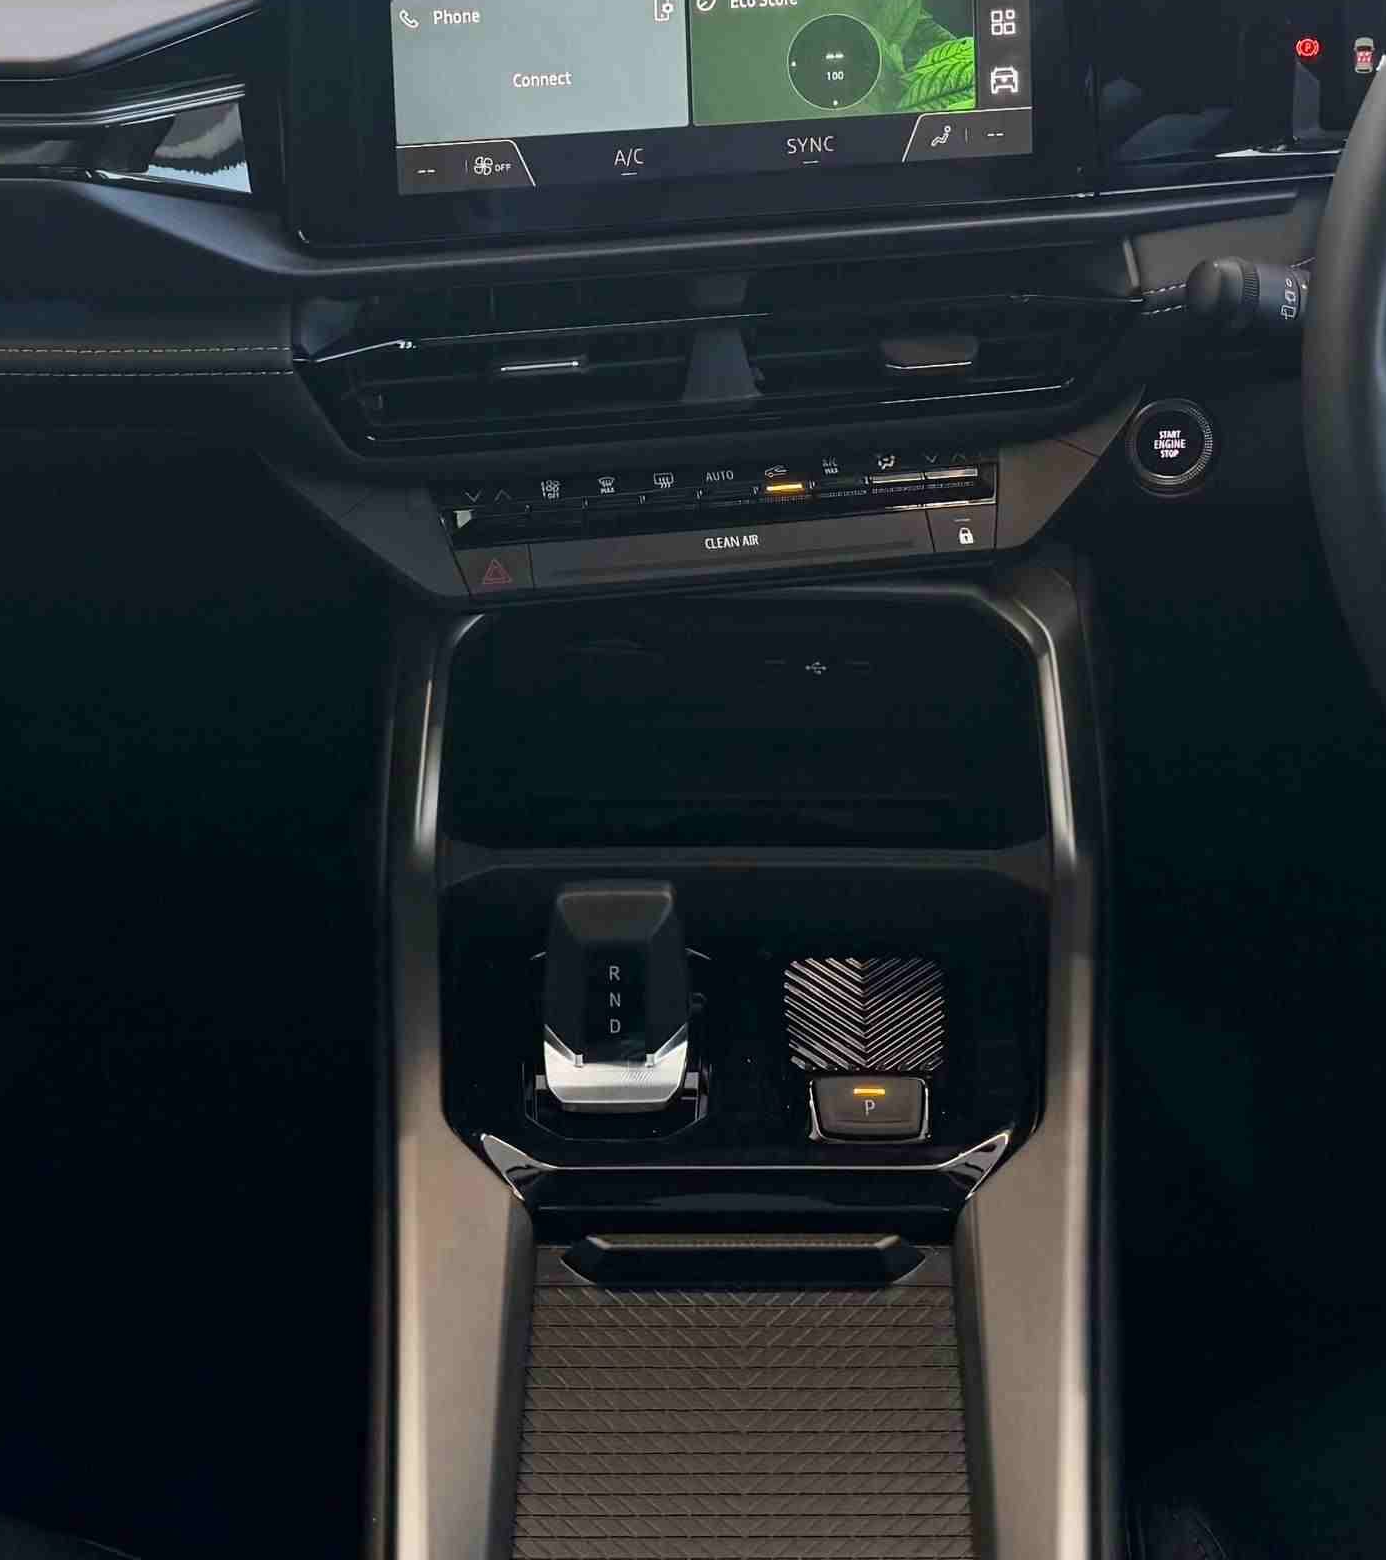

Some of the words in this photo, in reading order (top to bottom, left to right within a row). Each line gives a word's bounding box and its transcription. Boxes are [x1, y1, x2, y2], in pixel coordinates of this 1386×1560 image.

[433, 9, 481, 25] Phone
[513, 71, 573, 89] Connect
[826, 71, 844, 81] 100
[787, 135, 835, 154] SYNC
[614, 148, 646, 167] A/C
[495, 163, 512, 173] OFF
[1158, 430, 1182, 440] START
[1154, 439, 1187, 450] ENGINE
[1160, 449, 1180, 458] STOP
[705, 470, 734, 482] AUTO
[704, 536, 740, 549] CLEAN
[742, 534, 759, 546] AIR
[609, 965, 621, 981] R
[609, 992, 621, 1008] N
[609, 1019, 621, 1034] D
[865, 1099, 876, 1118] P
